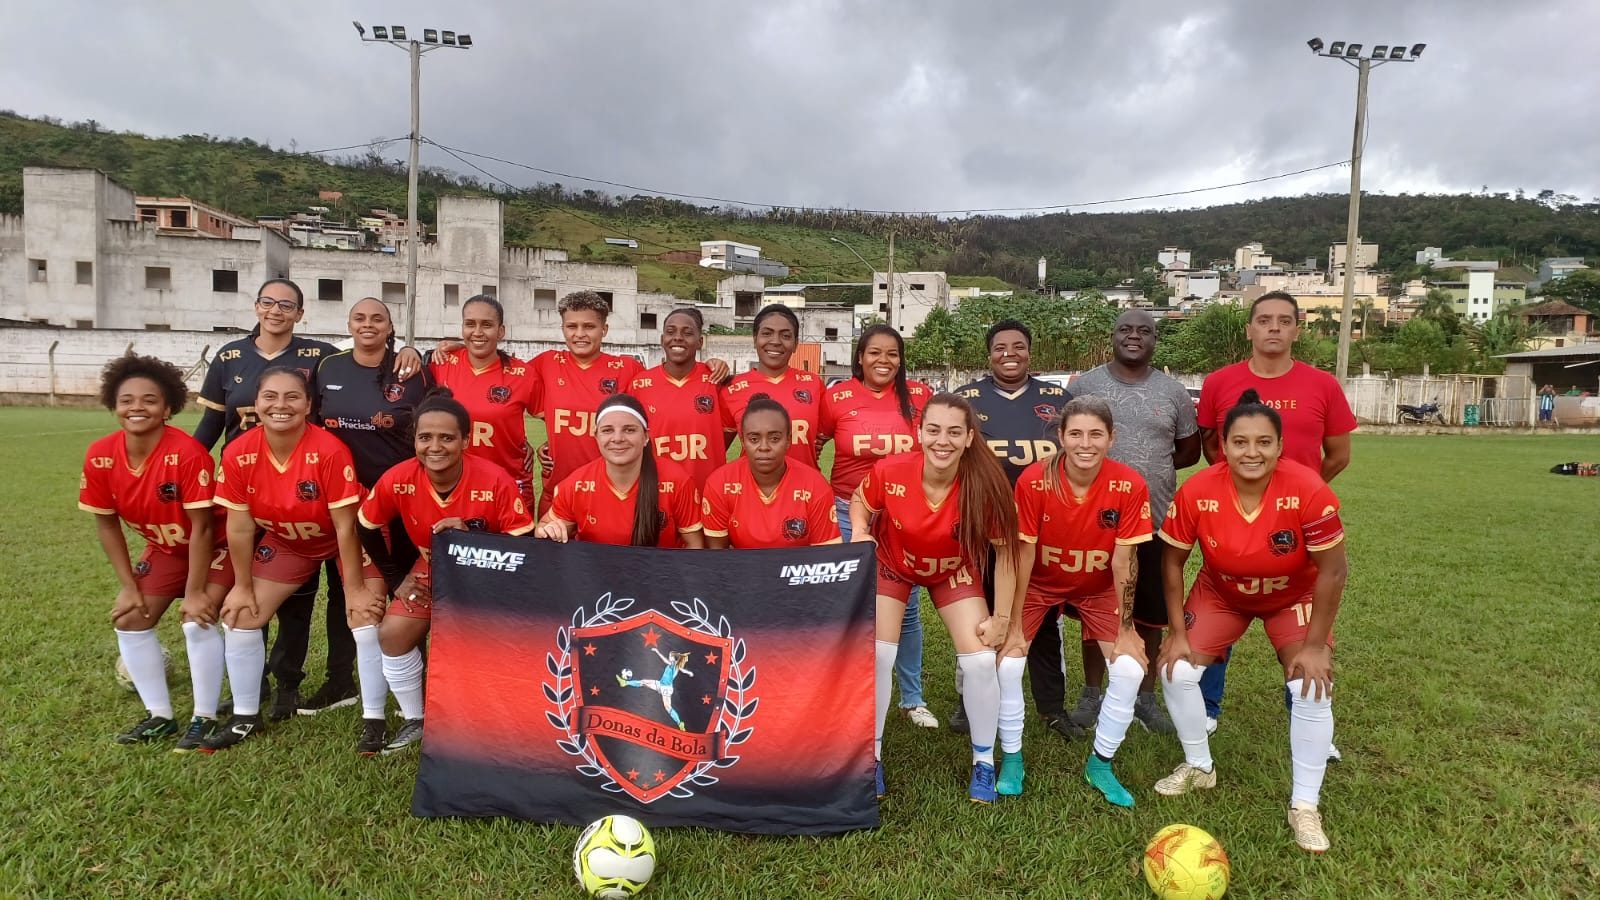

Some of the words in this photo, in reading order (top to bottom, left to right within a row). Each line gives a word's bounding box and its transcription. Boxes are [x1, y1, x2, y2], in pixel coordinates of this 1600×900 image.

[219, 349, 241, 362] FJR
[298, 347, 321, 358] FJR
[502, 366, 526, 377] FJR
[632, 378, 653, 390] FJR
[727, 380, 750, 394] FJR
[910, 387, 923, 395] JR
[832, 390, 854, 403] FJR
[1039, 387, 1064, 396] FJR
[1260, 399, 1297, 410] OSTE
[654, 433, 709, 461] FJR
[852, 433, 914, 457] FJR
[986, 439, 1058, 466] FJR
[392, 483, 416, 496] FJR
[575, 480, 596, 492] FJR
[658, 481, 674, 493] JR
[723, 482, 743, 495] FJR
[1108, 480, 1133, 493] FJR
[470, 490, 494, 502] FJR
[793, 489, 812, 503] FJR
[1275, 496, 1300, 511] FJR
[447, 543, 526, 565] INNOVE
[1041, 544, 1110, 573] FJR
[455, 556, 518, 572] SPORTS
[779, 558, 861, 578] INNOVE
[902, 548, 963, 577] FJR
[787, 571, 852, 586] SPORTS
[948, 565, 974, 589] 14
[1221, 575, 1290, 595] JR
[586, 713, 641, 739] Donas
[646, 728, 665, 747] da
[671, 735, 707, 756] Bola
